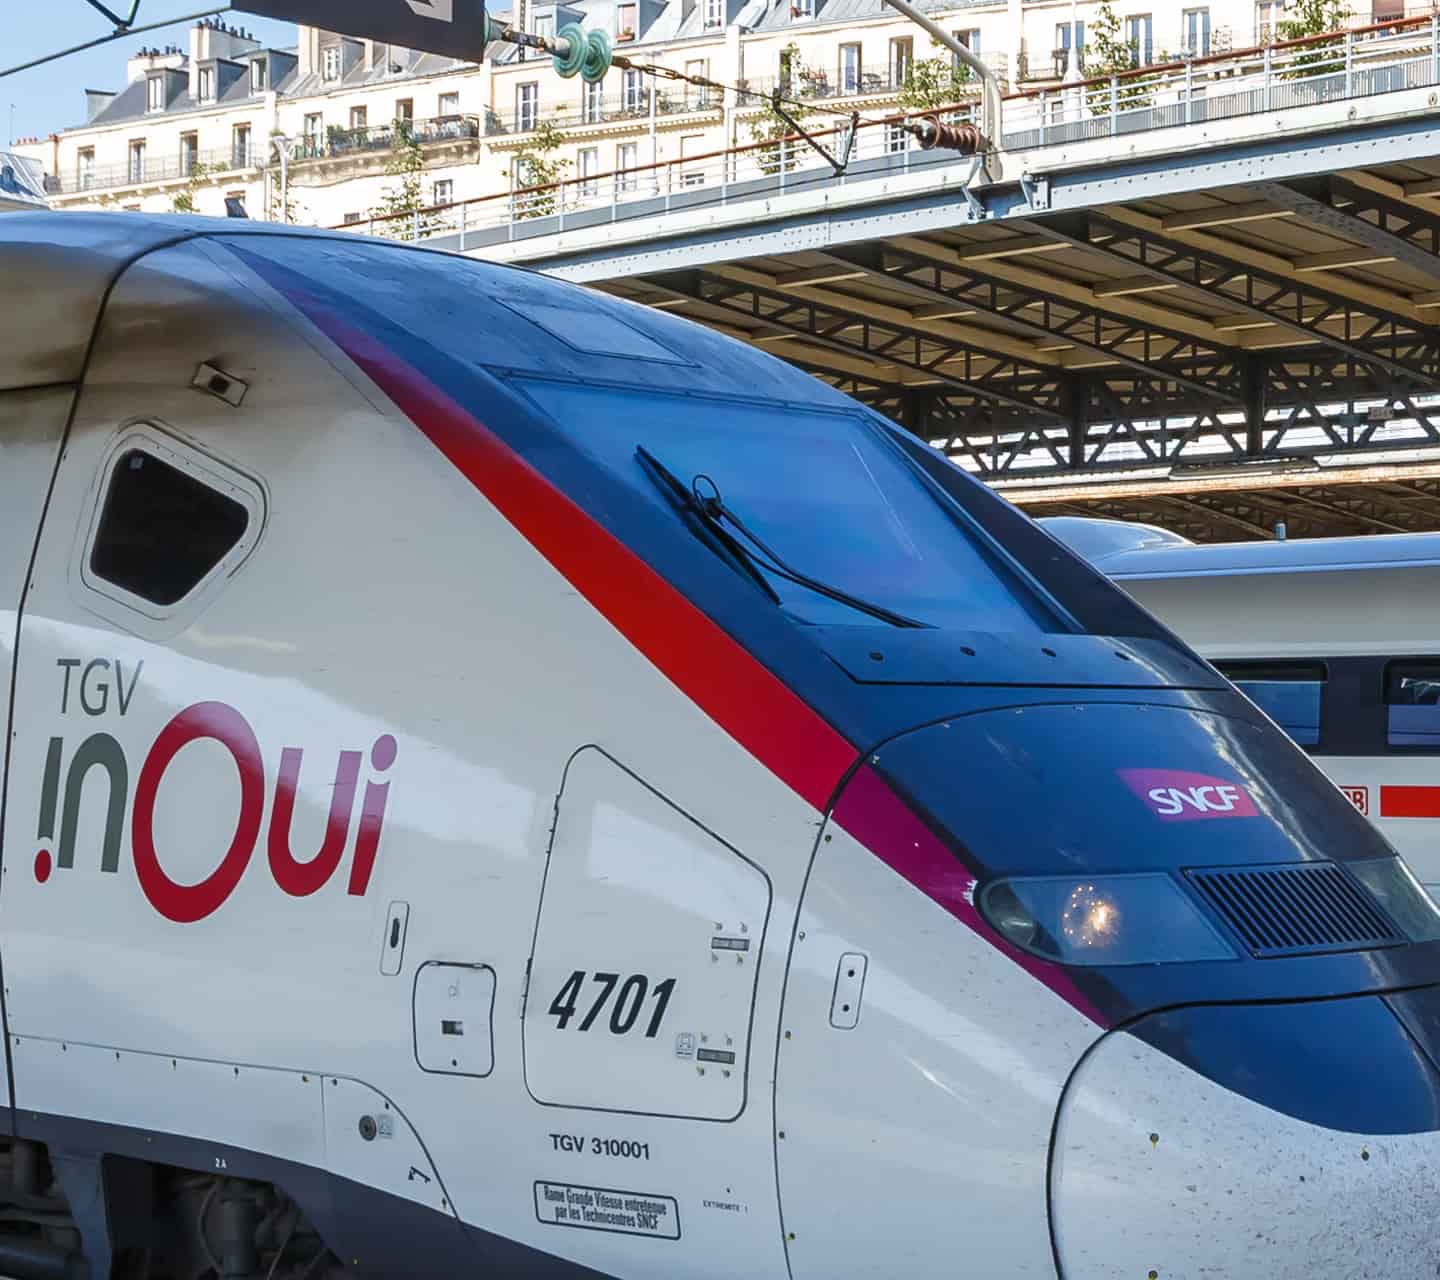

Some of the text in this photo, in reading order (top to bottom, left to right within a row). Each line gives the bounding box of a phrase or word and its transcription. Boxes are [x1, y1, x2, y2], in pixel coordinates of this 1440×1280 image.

[56, 657, 145, 717] TGV
[1148, 785, 1241, 815] SNCF
[547, 970, 678, 1039] 4701
[549, 1133, 650, 1161] TGV 310001
[543, 1185, 565, 1202] Rame
[566, 1187, 593, 1207] Grande
[593, 1191, 623, 1210] Vitesse
[568, 1203, 581, 1221] les
[581, 1205, 636, 1228] Technicentres
[636, 1211, 659, 1230] SNCF
